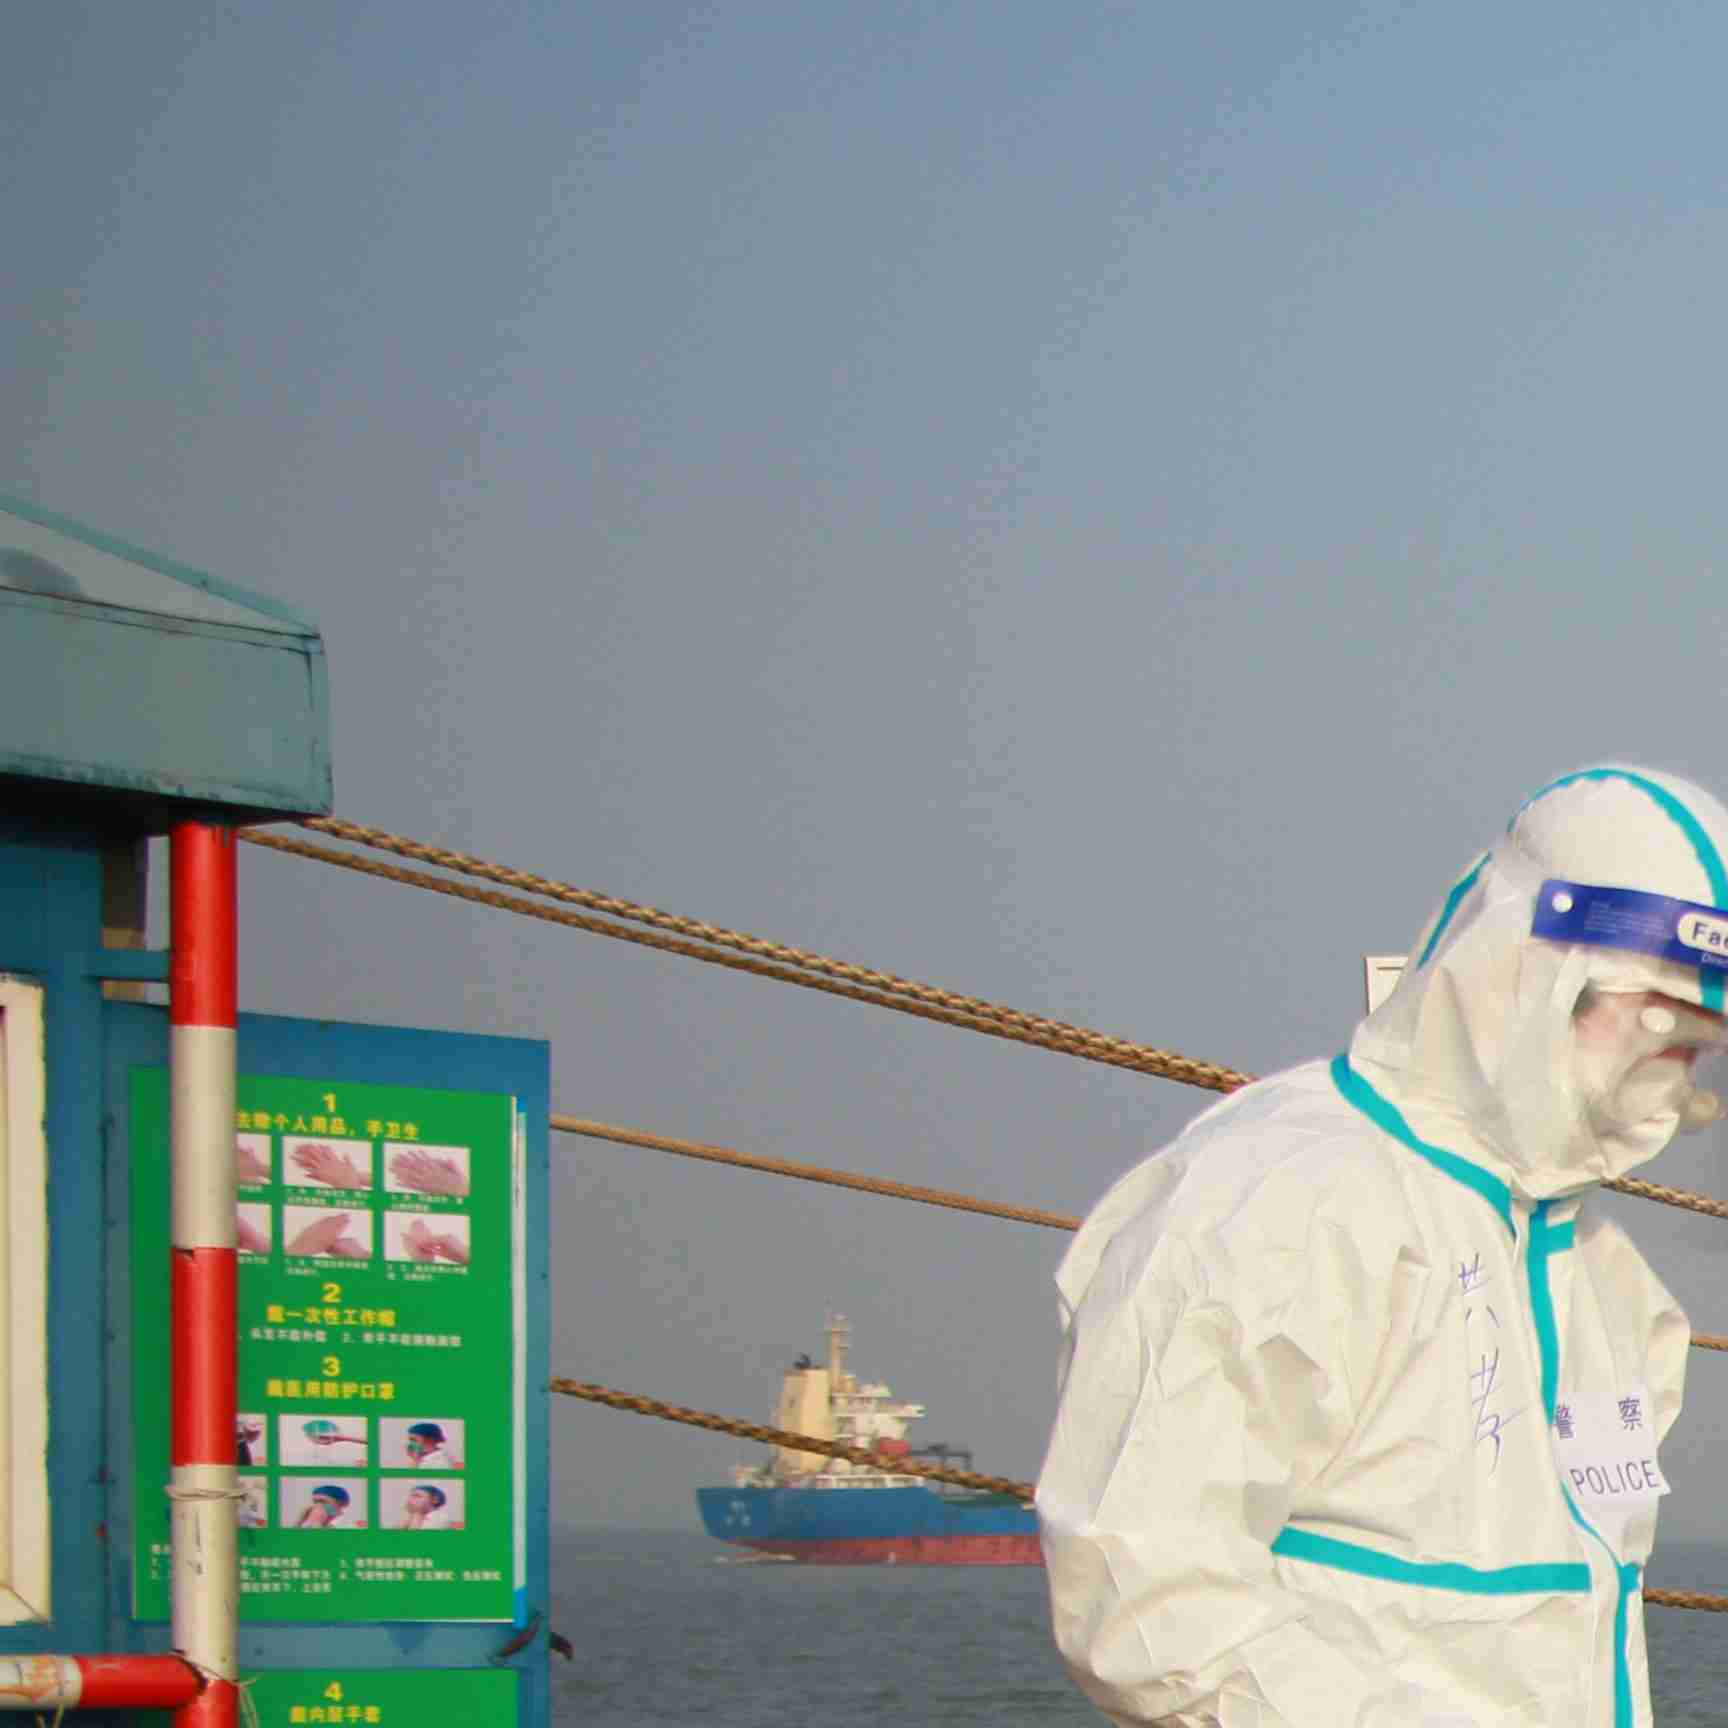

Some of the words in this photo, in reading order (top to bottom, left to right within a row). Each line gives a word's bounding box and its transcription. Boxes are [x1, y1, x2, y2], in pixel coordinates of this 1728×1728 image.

[322, 1092, 337, 1113] 1
[321, 1283, 342, 1304] 2
[321, 1355, 341, 1378] 3
[1555, 1397, 1643, 1440] 警察
[1569, 1459, 1660, 1496] POLICE
[324, 1680, 344, 1702] 4
